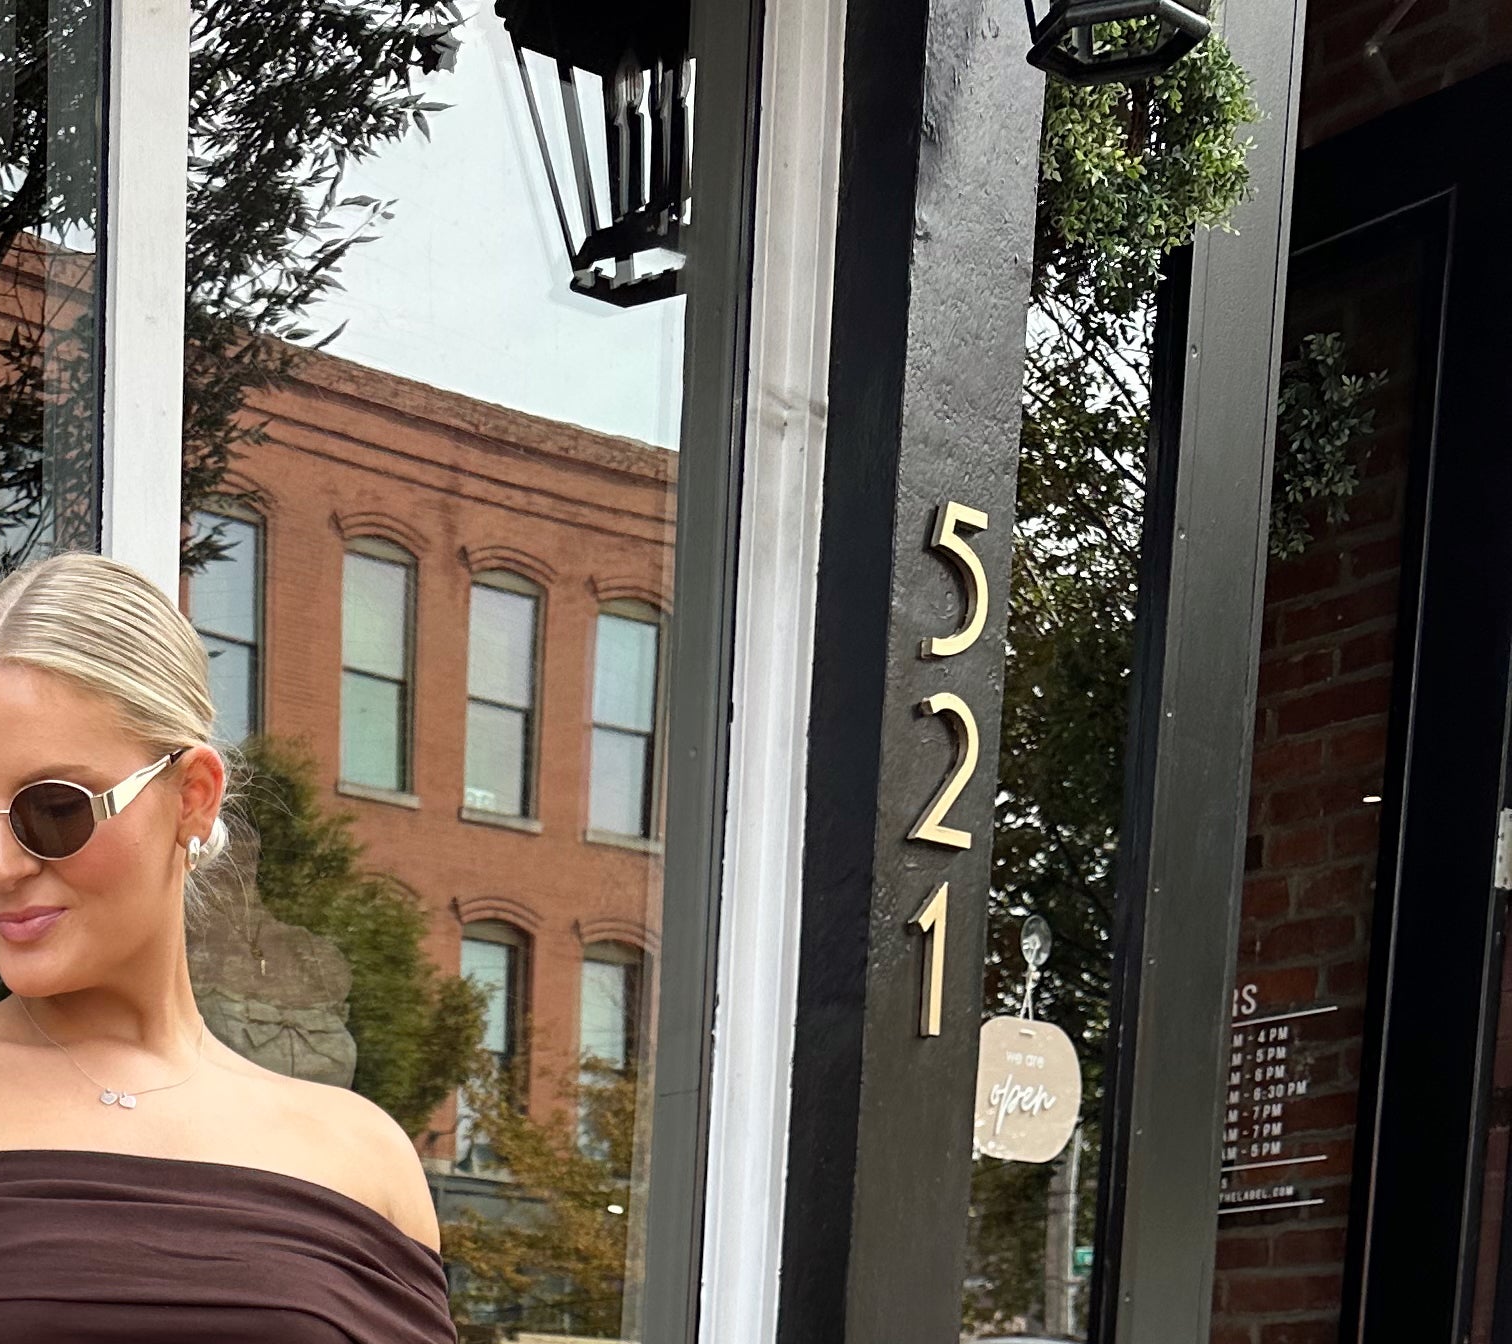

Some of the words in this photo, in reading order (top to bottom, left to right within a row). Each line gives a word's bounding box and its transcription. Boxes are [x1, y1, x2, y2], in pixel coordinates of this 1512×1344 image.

[907, 500, 989, 1037] 521
[1257, 1028, 1266, 1043] 4
[1269, 1026, 1289, 1042] PM
[1005, 1050, 1023, 1065] we
[1025, 1053, 1045, 1069] are
[1228, 1052, 1243, 1067] M
[1267, 1046, 1287, 1061] PM
[1226, 1071, 1241, 1086] M
[1266, 1064, 1286, 1080] PM
[1226, 1090, 1240, 1105] M
[1253, 1084, 1285, 1101] 6:30
[1287, 1080, 1307, 1097] PM
[990, 1073, 1057, 1135] open
[1224, 1108, 1239, 1124] M
[1252, 1105, 1260, 1120] 7
[1262, 1103, 1283, 1119] PM
[1252, 1124, 1260, 1139] 7
[1262, 1122, 1283, 1138] PM
[1262, 1140, 1282, 1156] PM
